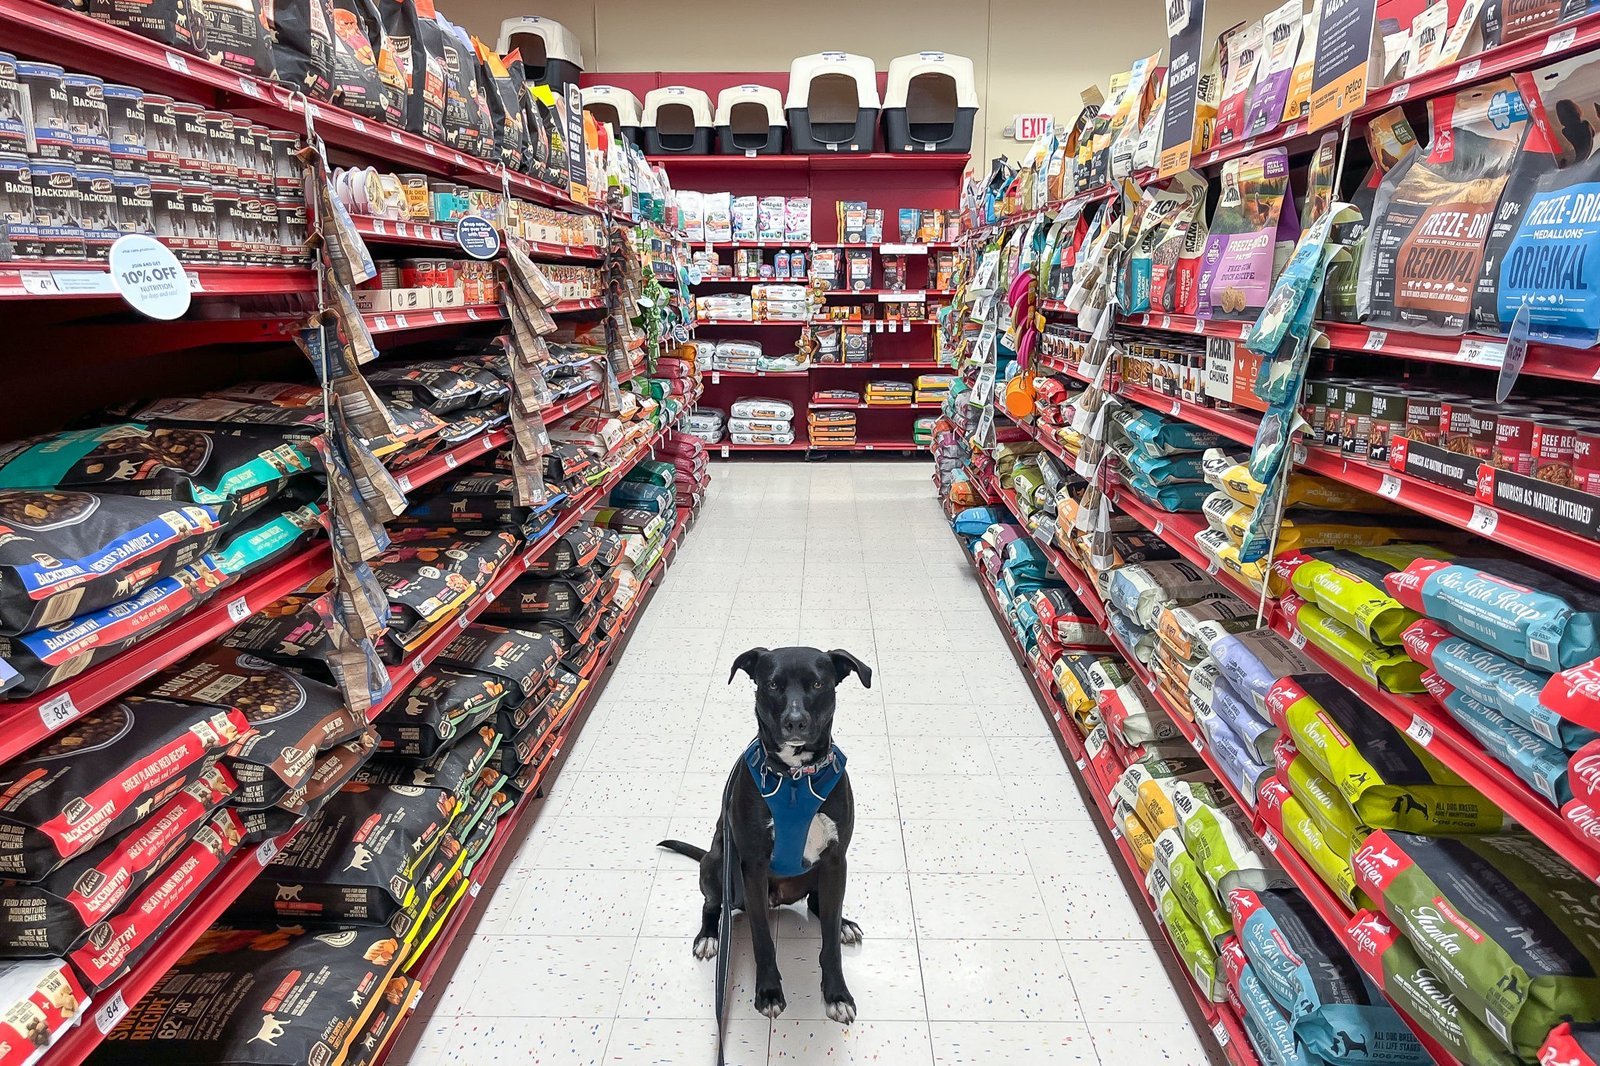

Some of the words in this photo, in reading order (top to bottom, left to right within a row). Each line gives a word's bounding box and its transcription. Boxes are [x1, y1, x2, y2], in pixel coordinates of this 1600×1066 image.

[1344, 78, 1362, 99] petco
[1023, 118, 1047, 138] EXIT
[1499, 202, 1521, 221] 90%
[1533, 229, 1584, 239] MEDALLIONS
[1402, 247, 1477, 284] REGIONAL
[1508, 244, 1588, 290] ORIGINAL
[122, 269, 151, 285] 10%
[153, 266, 177, 280] OFF
[140, 283, 173, 292] NUTRITION
[1209, 370, 1229, 385] CHUNKS
[1481, 420, 1493, 430] RED
[1541, 434, 1559, 446] BEEF
[1430, 460, 1442, 471] NATURE
[1497, 482, 1522, 502] NOURISH
[1523, 490, 1532, 506] AS
[1533, 492, 1558, 513] NATURE
[1558, 499, 1592, 524] INTENDED
[118, 534, 155, 557] BANQUET
[1314, 573, 1344, 595] Senior
[1437, 572, 1460, 589] Six
[1456, 579, 1491, 604] Fish
[43, 619, 100, 651] BACKCOUNTRY
[1444, 642, 1470, 660] Six
[122, 776, 140, 793] GREAT
[140, 765, 160, 784] PLAINS
[159, 755, 171, 768] RED
[170, 744, 189, 762] RECIPE
[0, 824, 11, 833] FOR
[11, 826, 26, 834] DOGS
[1, 841, 24, 849] CHIENS
[14, 853, 24, 861] WT
[1355, 846, 1385, 887] Orijen
[157, 880, 175, 901] PLAINS
[174, 870, 184, 883] RED
[183, 856, 199, 873] RECIPE
[20, 898, 31, 906] FOR
[32, 898, 47, 906] DOGS
[24, 914, 47, 922] CHIENS
[1409, 905, 1462, 957] Tundra
[46, 976, 62, 993] RAW
[1270, 1020, 1298, 1062] Recipe
[1374, 1032, 1384, 1041] ALL
[1374, 1041, 1384, 1050] ALL
[1385, 1041, 1398, 1051] LIFE
